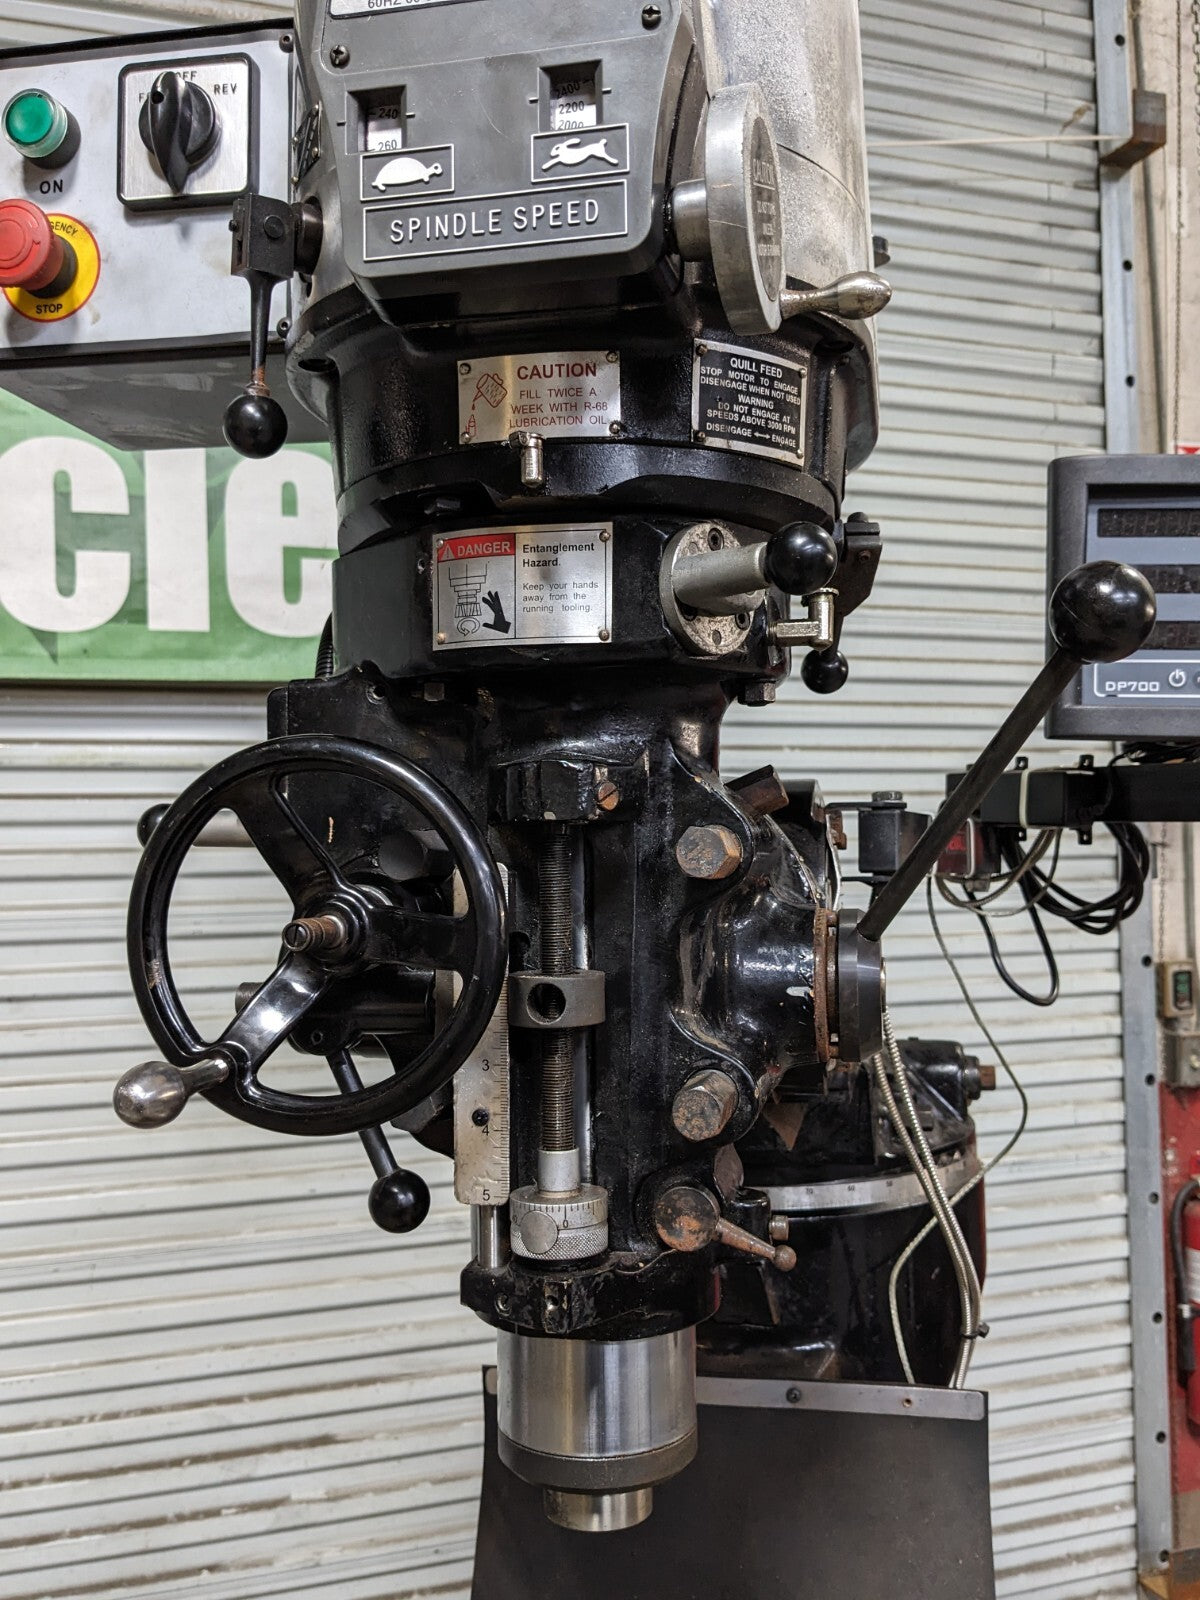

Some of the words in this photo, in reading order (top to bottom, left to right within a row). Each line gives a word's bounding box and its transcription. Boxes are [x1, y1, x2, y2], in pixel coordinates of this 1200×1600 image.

[213, 83, 238, 95] REV
[378, 107, 399, 120] 240
[558, 100, 585, 115] 2200
[377, 139, 398, 151] 260
[39, 179, 64, 195] ON
[389, 209, 502, 243] SPINDLE
[513, 198, 600, 230] SPEED
[50, 221, 79, 236] GENCY
[35, 303, 63, 315] STOP
[517, 362, 597, 380] CAUTION
[730, 357, 758, 372] QUILL
[760, 364, 783, 379] FEED
[700, 366, 723, 376] STOP
[728, 370, 755, 383] MOTOR
[760, 377, 770, 387] TO
[773, 381, 799, 395] ENGAGE
[519, 389, 541, 399] FILL
[547, 387, 583, 398] TWICE
[589, 387, 597, 397] A
[700, 376, 748, 391] DISENGAGE
[748, 384, 770, 396] WHEN
[771, 389, 785, 400] NOT
[785, 394, 801, 406] USED
[510, 403, 544, 415] WEEK
[549, 402, 578, 413] WITH
[584, 401, 608, 411] R-68
[738, 394, 774, 410] WARNING
[718, 401, 730, 411] DO
[733, 404, 749, 414] NOT
[752, 407, 780, 422] ENGAGE
[782, 415, 791, 424] AT
[509, 415, 583, 429] LUBRICATION
[589, 415, 608, 424] OIL
[706, 409, 739, 422] SPEEDS
[741, 414, 766, 427] ABOVE
[783, 425, 796, 435] RPM
[706, 423, 753, 437] DISENGAGE
[771, 434, 797, 448] ENGAGE
[457, 541, 511, 557] DANGER
[522, 542, 595, 554] Entanglement
[522, 557, 561, 567] Hazard.
[522, 582, 544, 591] Keep
[549, 583, 568, 591] your
[572, 581, 599, 589] hands
[522, 594, 544, 602] away
[549, 592, 568, 601] from
[573, 592, 587, 600] the
[522, 604, 554, 613] running
[561, 603, 593, 613] tooling.
[1105, 681, 1160, 692] DP700
[481, 1059, 490, 1071] 3
[481, 1124, 490, 1136] 4
[482, 1189, 491, 1201] 5
[562, 1219, 569, 1228] 0
